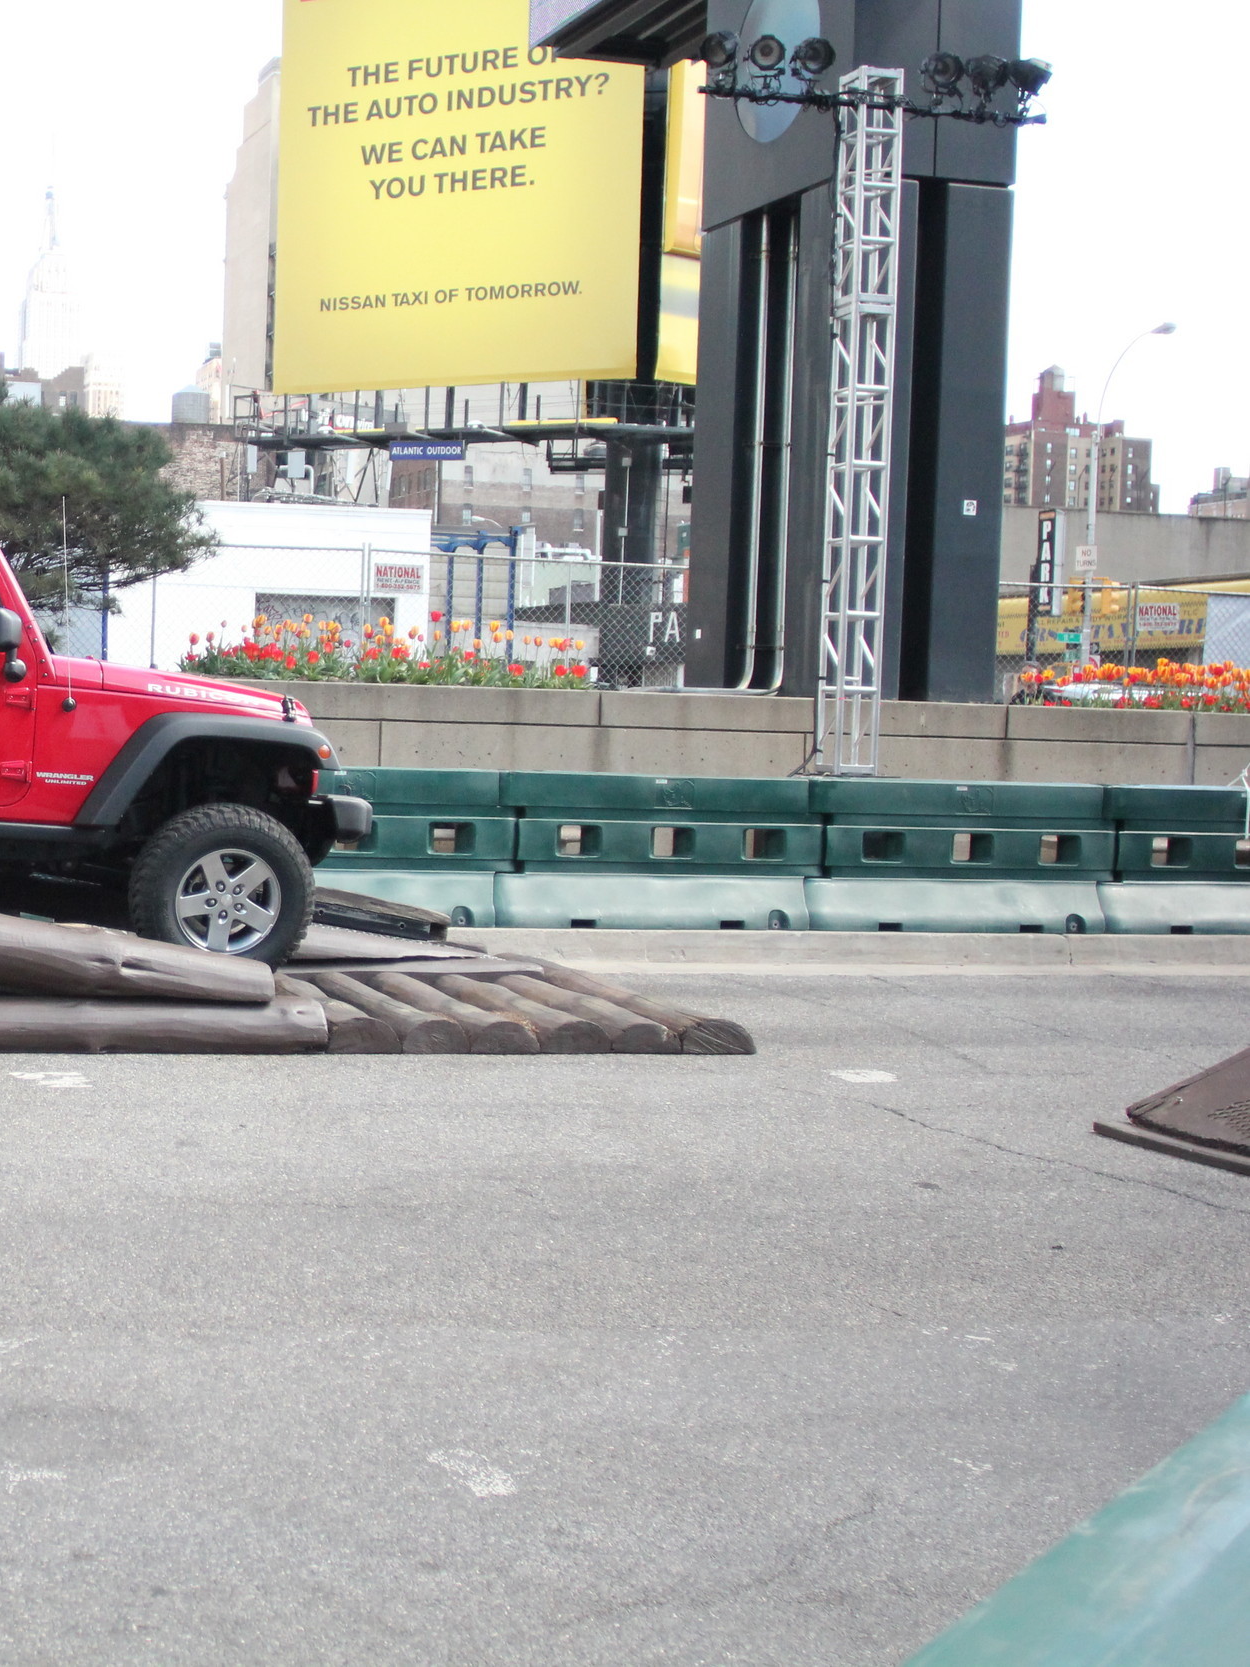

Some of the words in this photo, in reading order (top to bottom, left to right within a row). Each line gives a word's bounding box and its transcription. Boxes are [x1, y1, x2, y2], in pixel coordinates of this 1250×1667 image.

[347, 61, 399, 87] THE
[407, 46, 519, 79] FUTURE
[307, 101, 358, 127] THE
[366, 89, 438, 121] AUTO
[446, 72, 611, 111] INDUSTRY?
[361, 141, 404, 166] WE
[411, 134, 468, 161] CAN
[475, 126, 547, 154] TAKE
[369, 174, 426, 200] YOU
[434, 164, 535, 194] THERE.
[320, 294, 387, 312] NISSAN
[392, 291, 429, 307] TAXI
[434, 288, 460, 304] OF
[465, 280, 583, 302] TOMORROW.
[392, 446, 424, 455] ATLANTIC
[426, 446, 462, 455] OUTDOOR
[1039, 520, 1052, 604] PARK
[1076, 558, 1097, 567] TURNS
[1081, 549, 1092, 557] NO
[376, 565, 422, 579] NATIONAL
[1138, 605, 1178, 616] NATIONAL
[36, 771, 94, 781] WRANGLER
